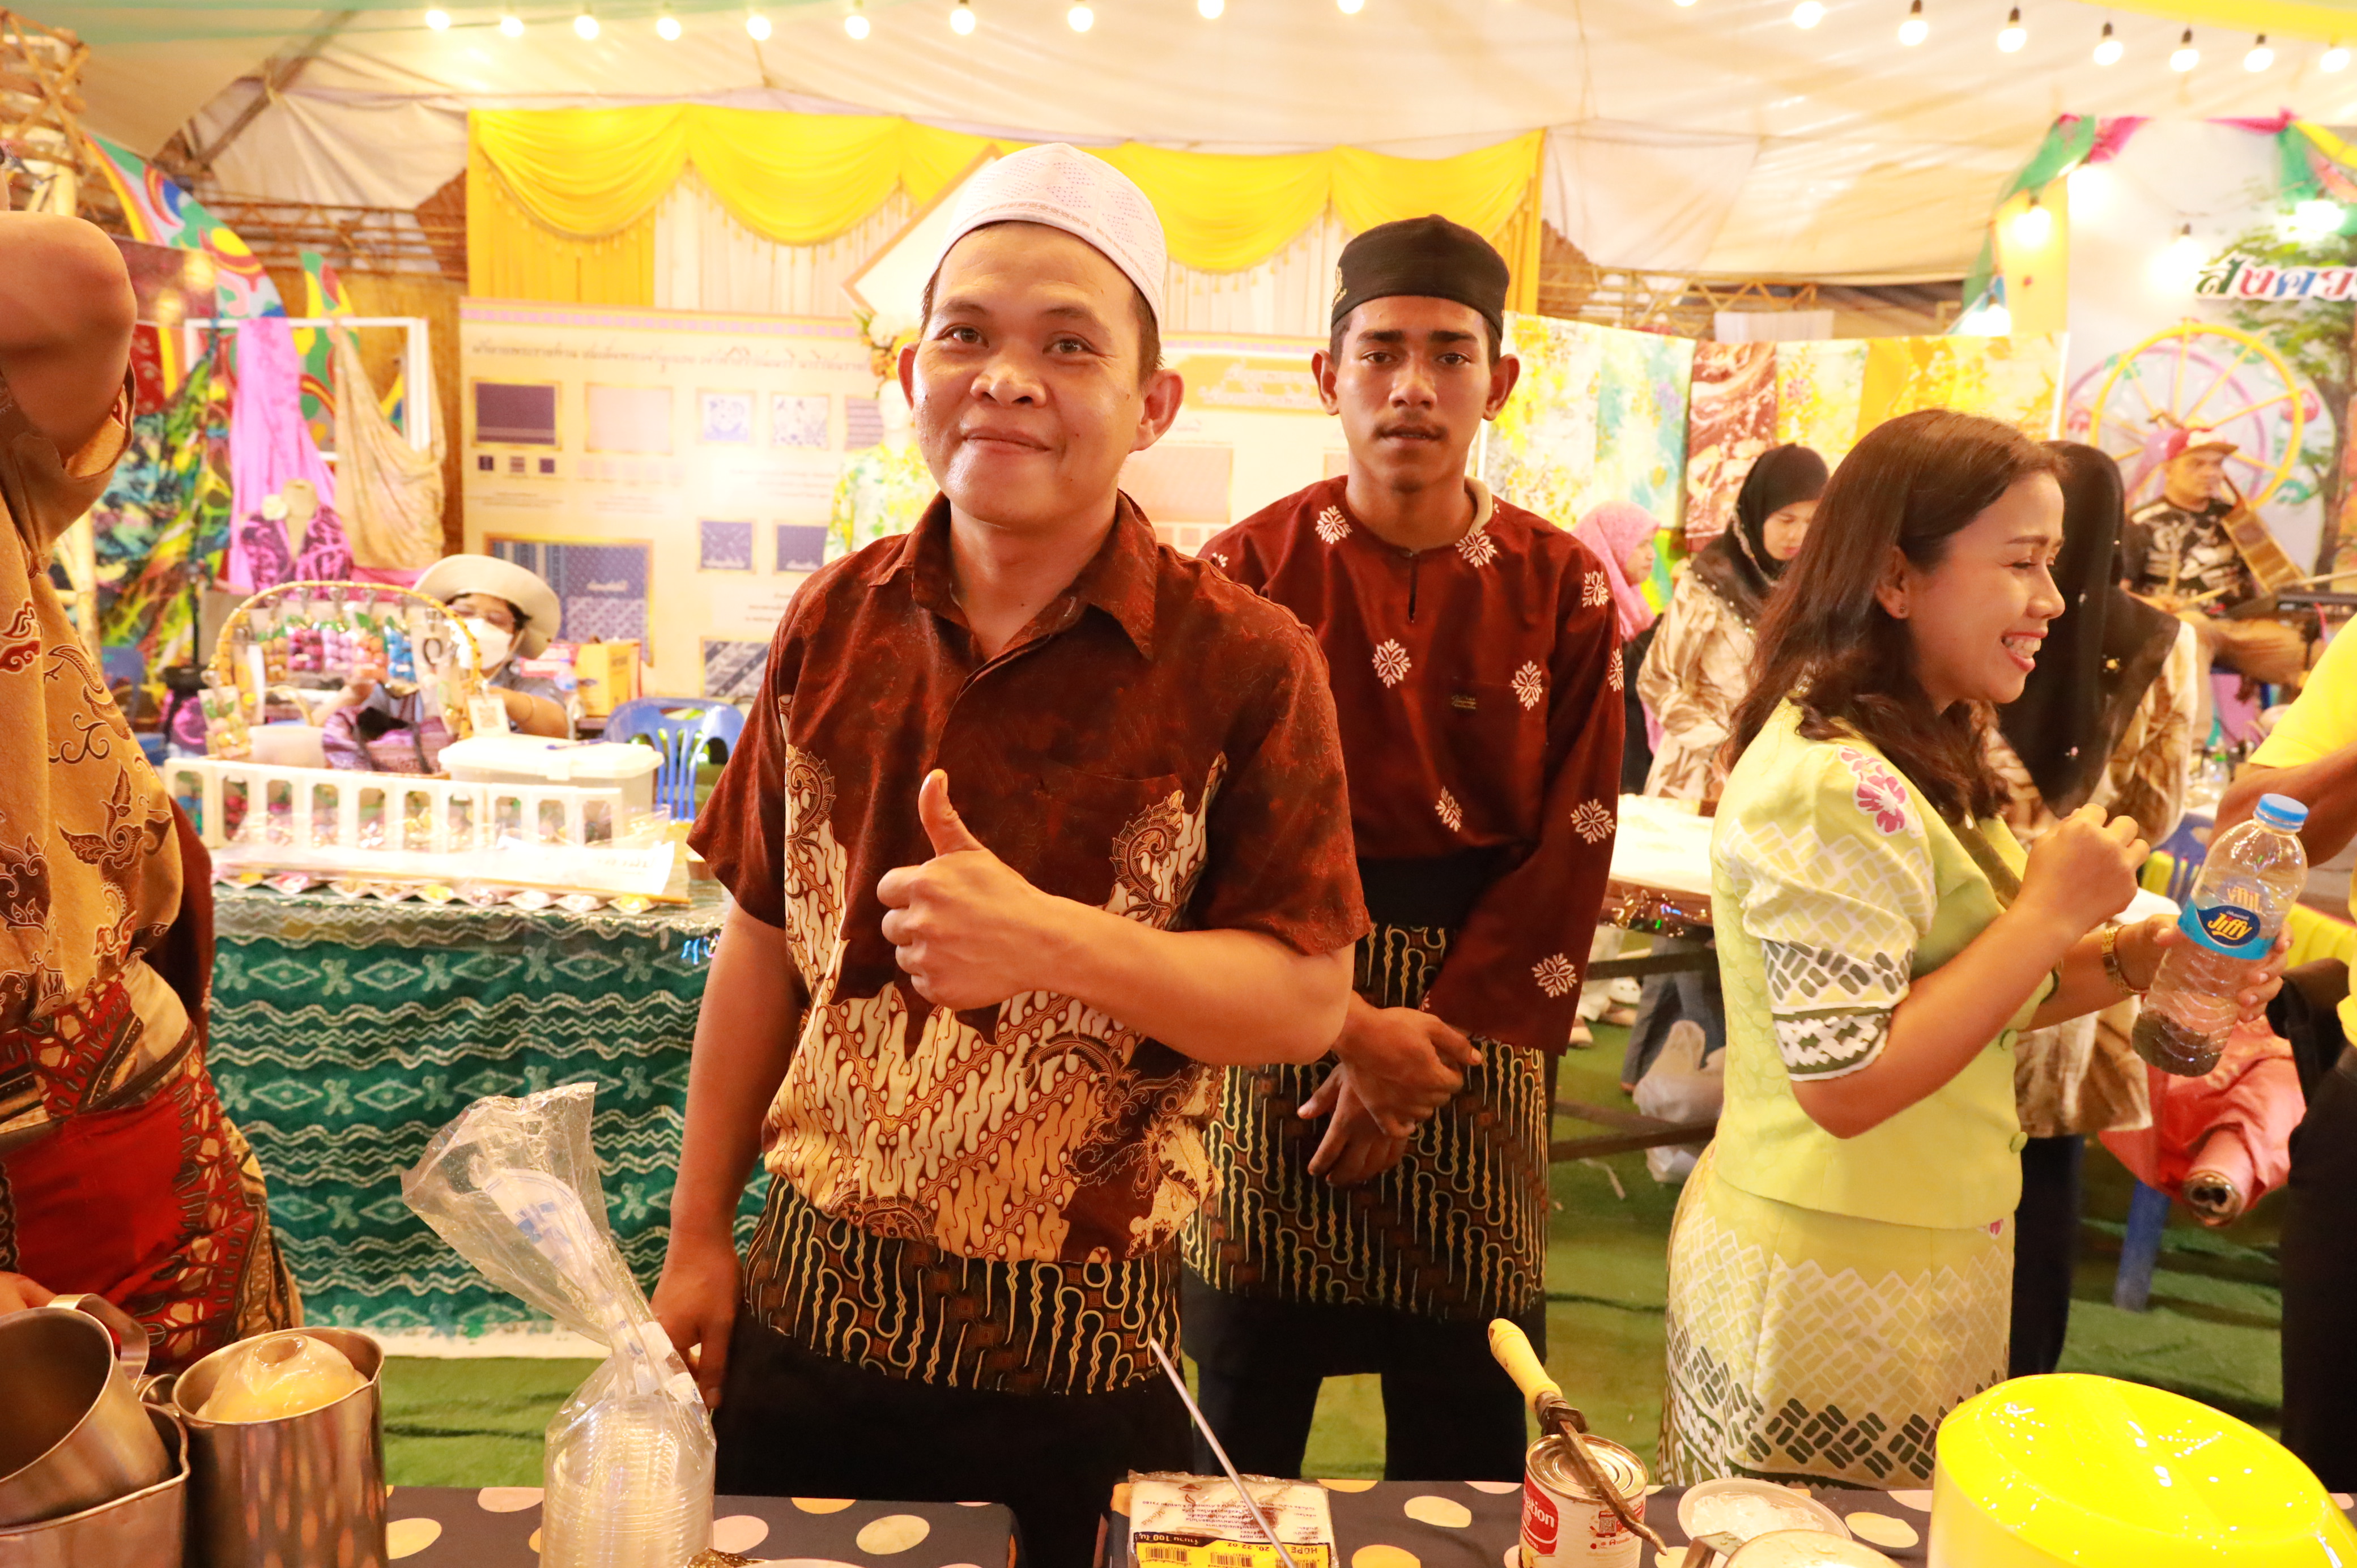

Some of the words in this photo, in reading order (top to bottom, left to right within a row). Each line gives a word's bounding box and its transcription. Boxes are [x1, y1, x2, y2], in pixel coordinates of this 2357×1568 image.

[2207, 913, 2253, 940] Jiffy
[1141, 1508, 1166, 1526] Mocha
[1173, 1536, 1199, 1545] จำนวน
